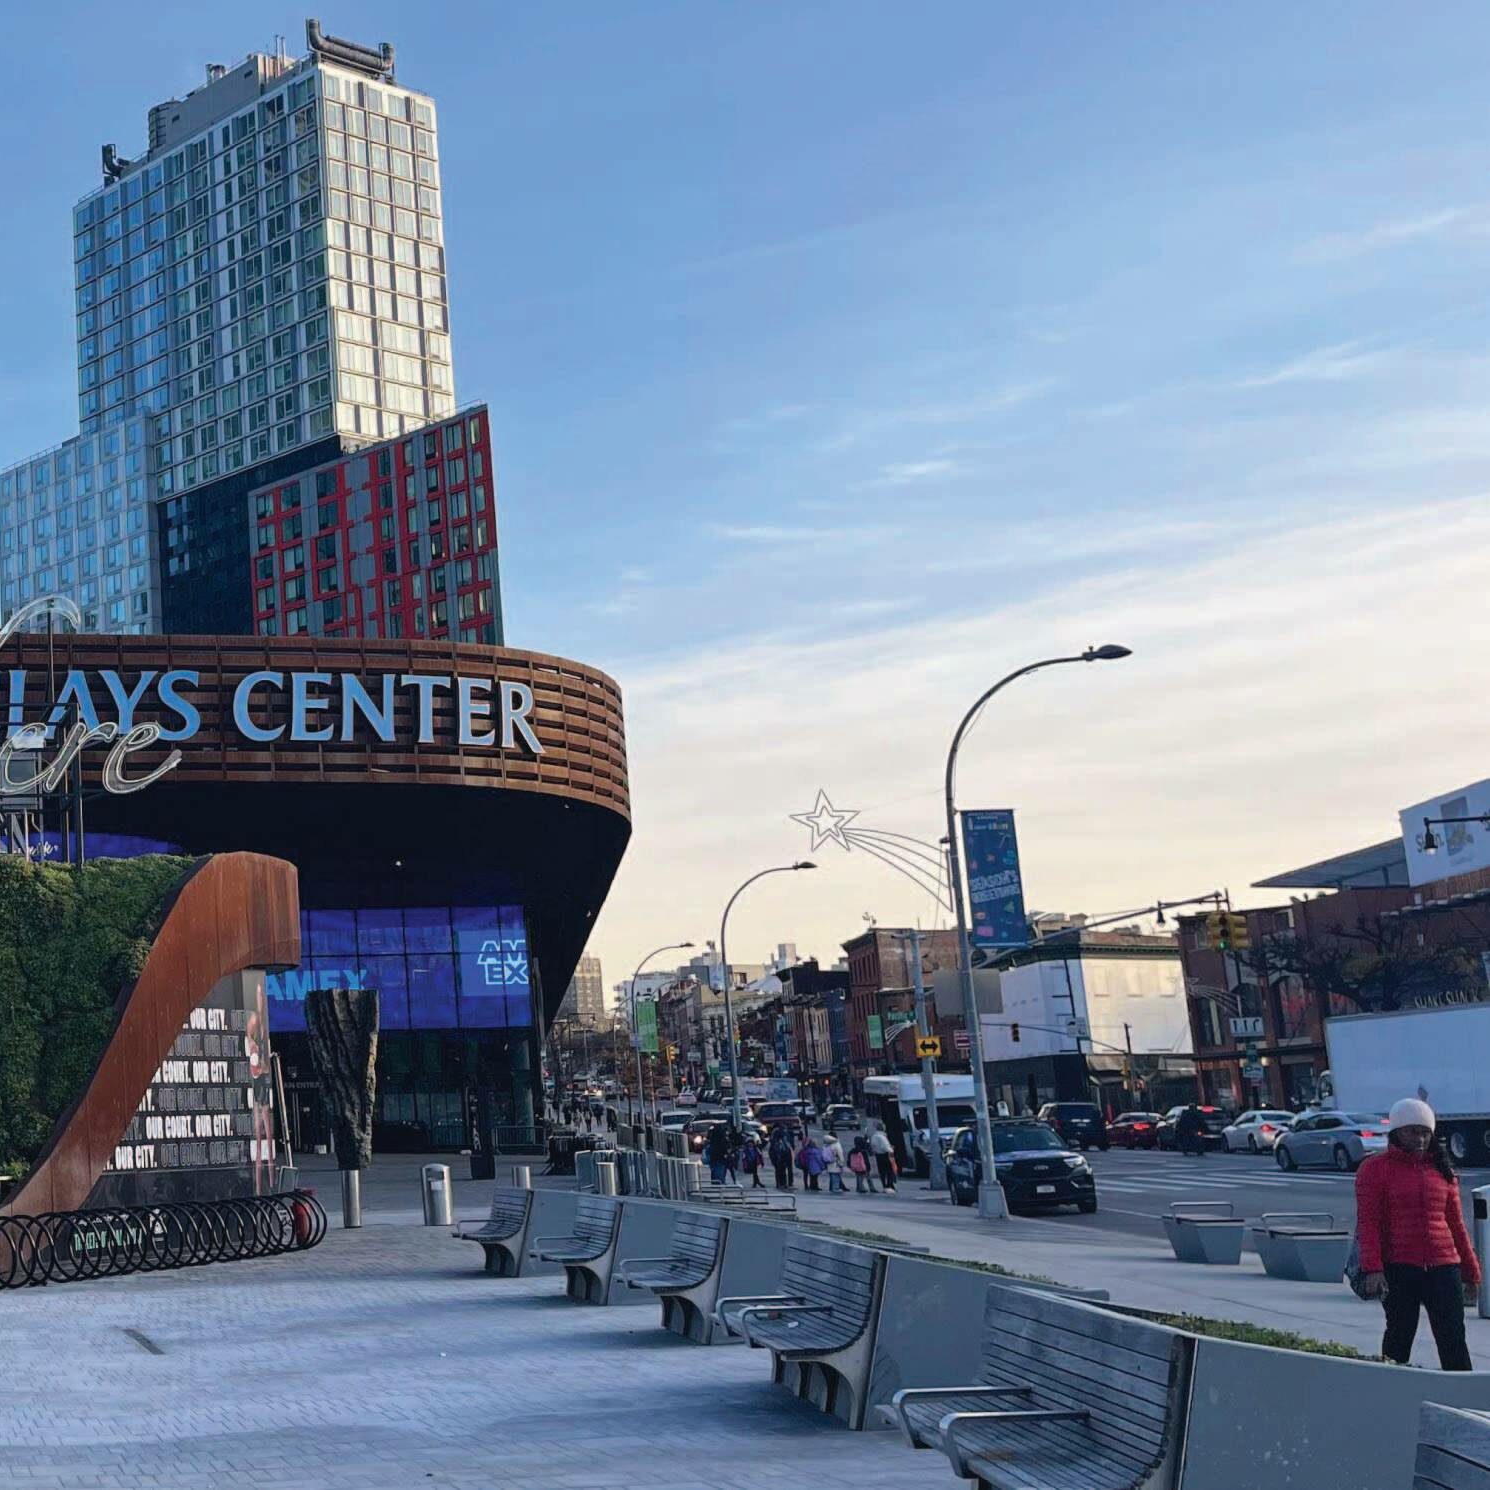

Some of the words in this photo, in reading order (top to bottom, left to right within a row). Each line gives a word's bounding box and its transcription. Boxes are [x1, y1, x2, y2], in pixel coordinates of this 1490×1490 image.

[232, 671, 546, 755] CENTER
[477, 939, 526, 965] AM
[265, 969, 368, 1001] AMEX
[485, 962, 529, 985] EX
[190, 1008, 207, 1030] OUR
[208, 1008, 228, 1030] CITY.
[162, 1060, 192, 1083] COURT.
[193, 1060, 209, 1083] OUR
[210, 1060, 231, 1083] CITY.
[146, 1116, 164, 1139] OUR
[165, 1115, 194, 1139] COURT.
[196, 1115, 212, 1137] OUR
[213, 1114, 234, 1137] CITY.
[115, 1145, 134, 1170] OUR
[135, 1144, 158, 1169] CITY.
